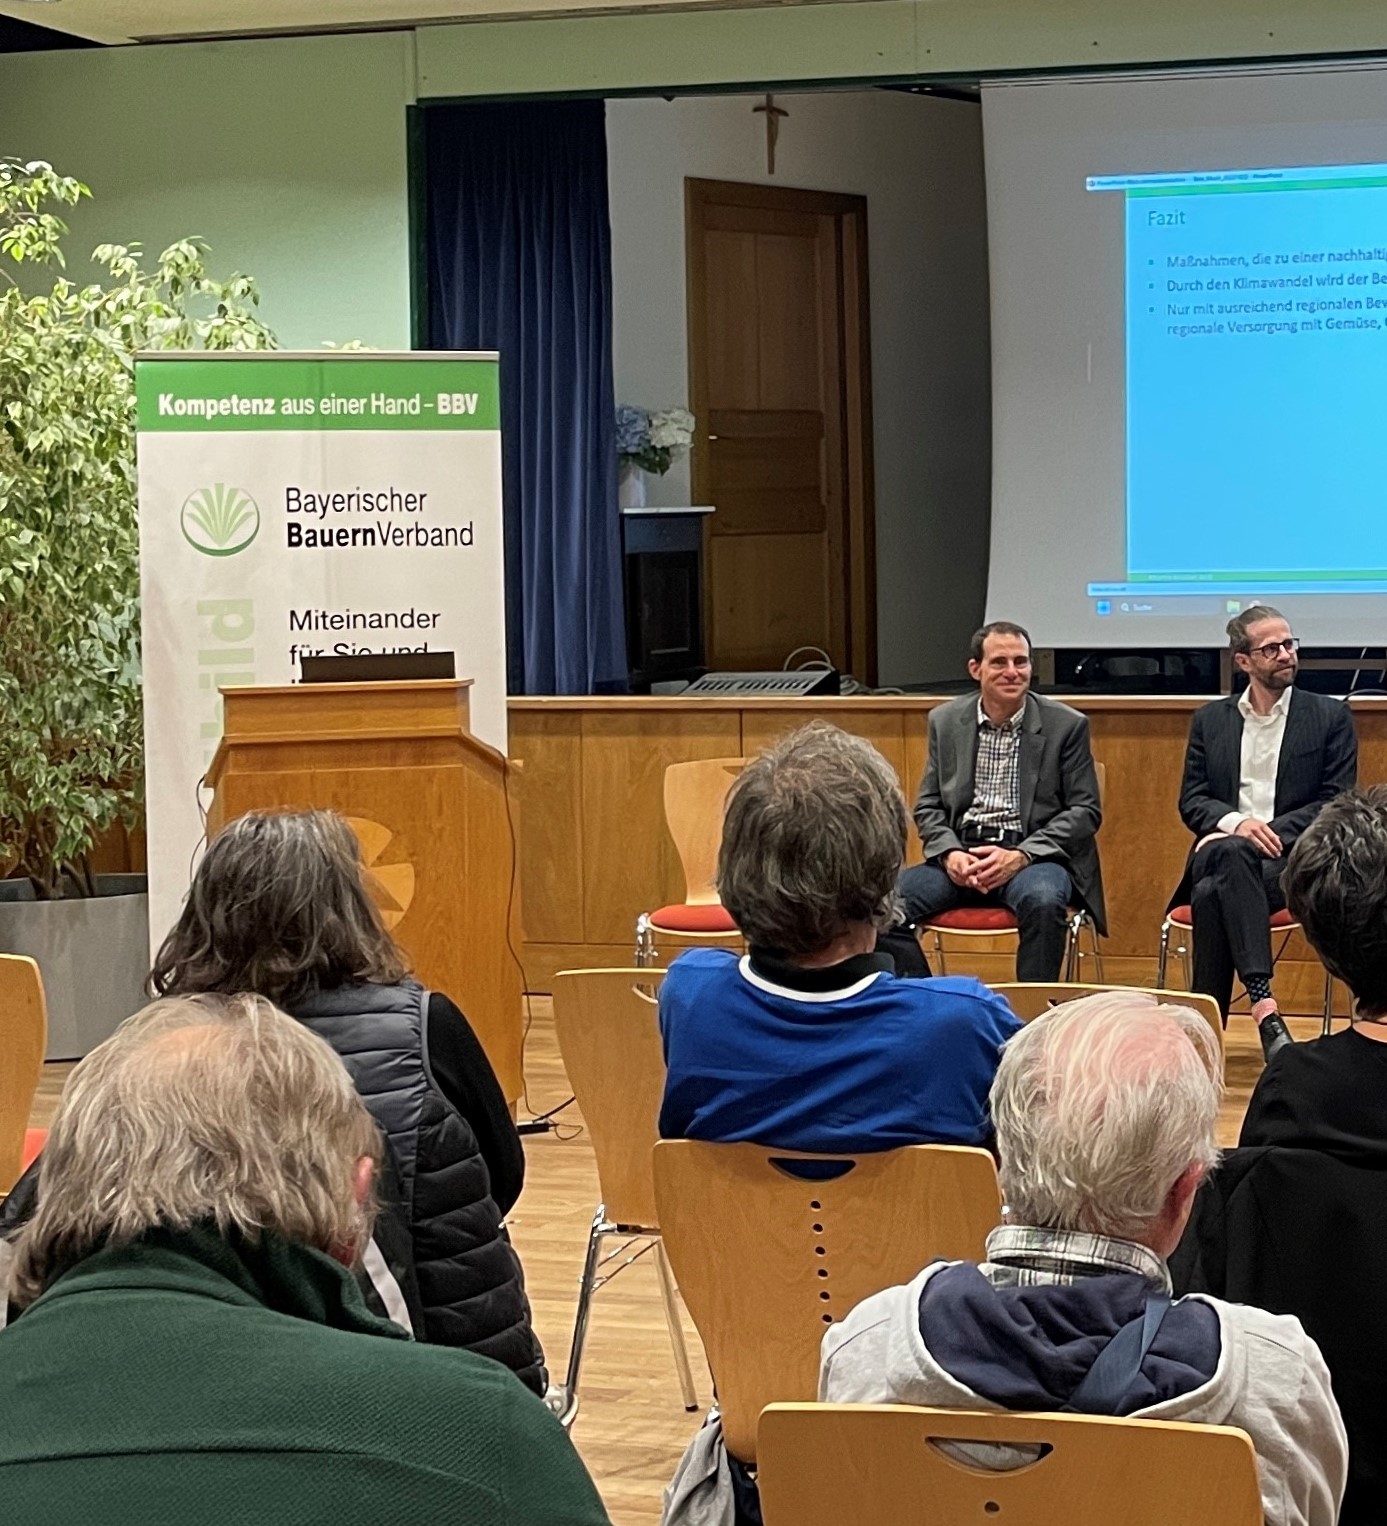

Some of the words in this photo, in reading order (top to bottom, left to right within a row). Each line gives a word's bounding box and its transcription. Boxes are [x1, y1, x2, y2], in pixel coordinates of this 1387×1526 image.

[1148, 210, 1186, 226] Fazit
[1167, 254, 1249, 269] Maßnahmen,
[1252, 253, 1271, 265] die
[1274, 254, 1289, 265] zu
[1292, 252, 1324, 264] einer
[1167, 279, 1202, 292] Durch
[1206, 278, 1230, 290] den
[1233, 275, 1312, 289] Klimawandel
[1316, 273, 1344, 287] wird
[1347, 273, 1369, 286] der
[1167, 304, 1190, 315] Nur
[1194, 303, 1214, 315] mit
[1217, 300, 1292, 314] ausreichend
[1296, 297, 1362, 314] regionalen
[1167, 323, 1224, 337] regionale
[1227, 320, 1298, 335] Versorgung
[1301, 318, 1322, 331] mit
[1325, 316, 1381, 331] Gemüse,
[158, 393, 275, 420] Kompetenz
[281, 398, 314, 415] aus
[320, 394, 367, 415] einer
[371, 392, 420, 415] Hand
[437, 392, 478, 415] BBV
[286, 487, 427, 520] Bayerischer
[287, 521, 473, 548] BauernVerband
[289, 608, 441, 631] Miteinander
